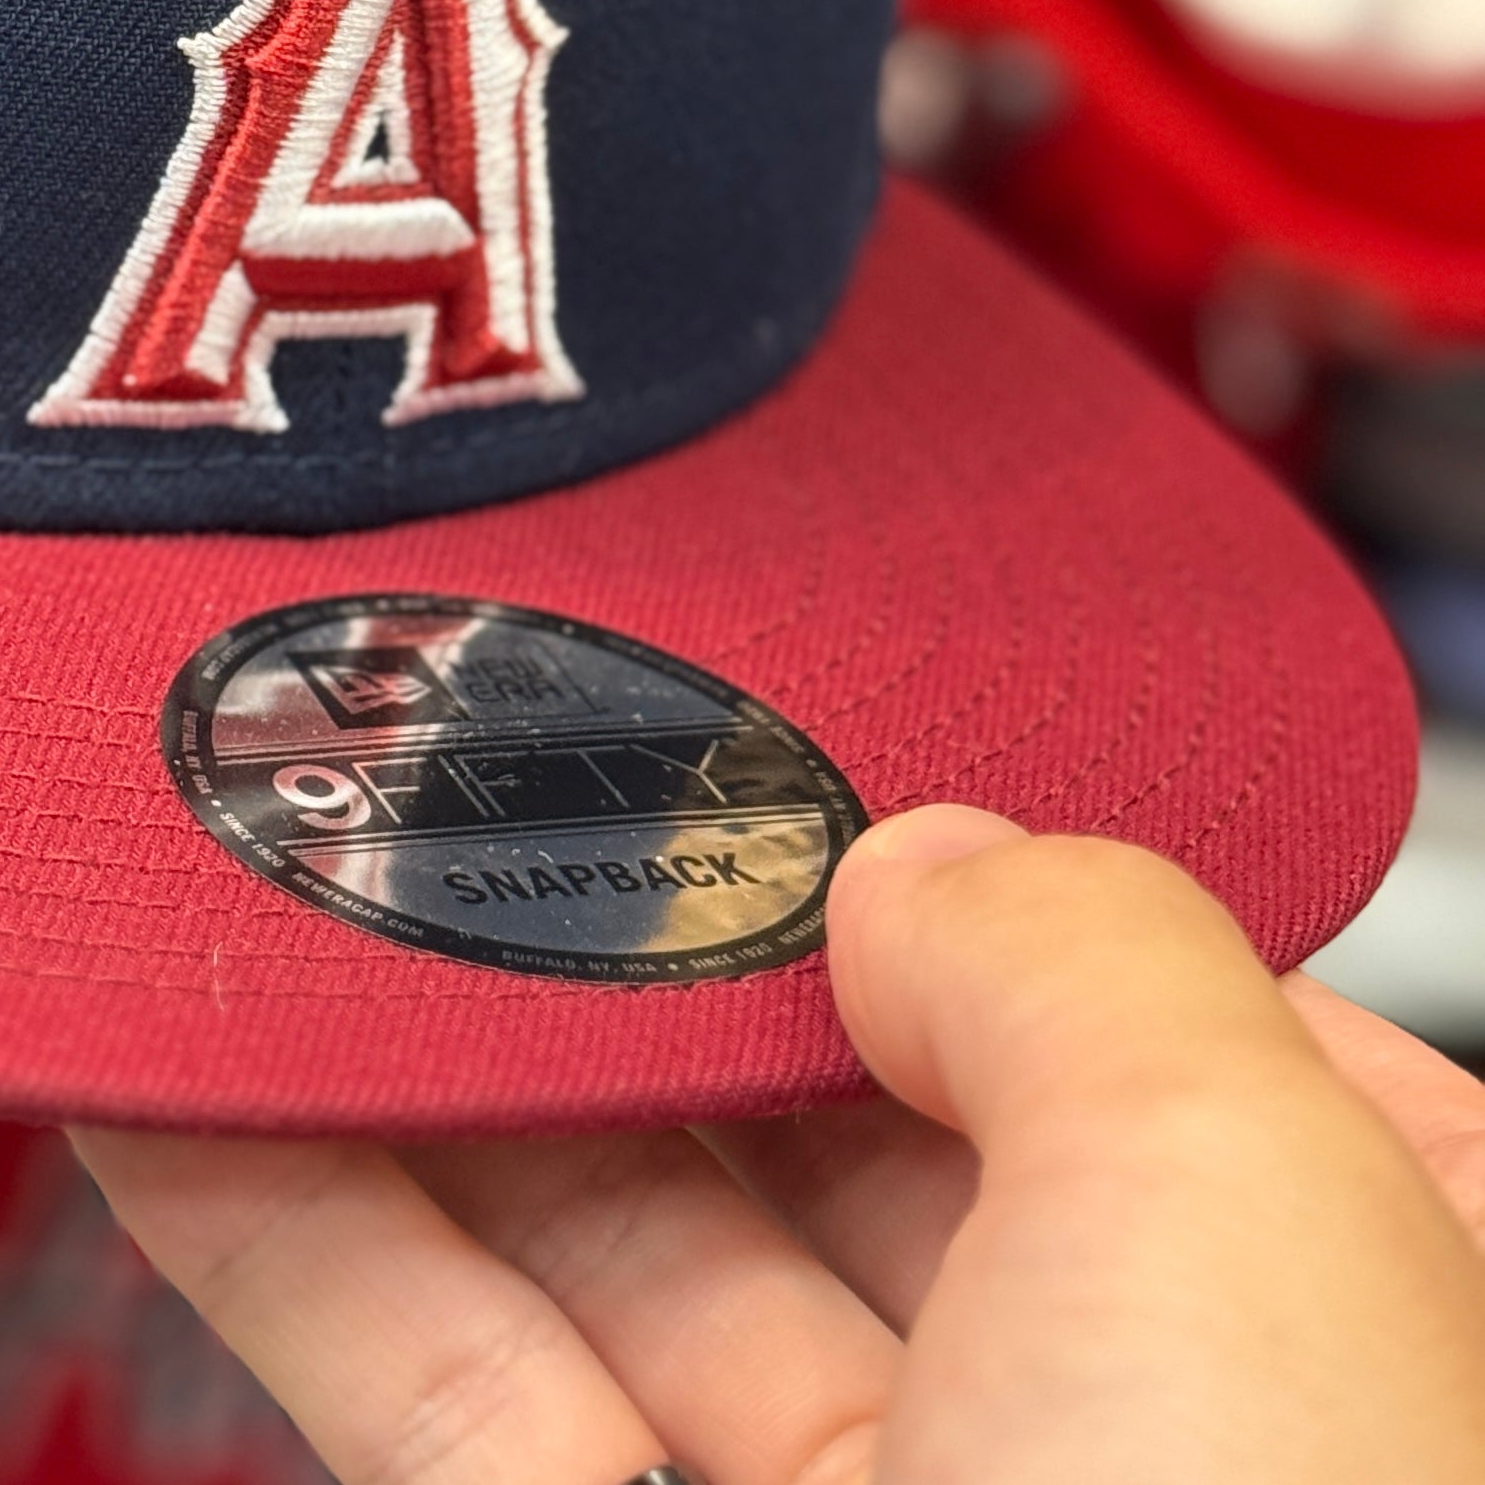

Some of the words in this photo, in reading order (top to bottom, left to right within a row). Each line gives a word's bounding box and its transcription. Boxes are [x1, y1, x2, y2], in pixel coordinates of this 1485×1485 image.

[450, 656, 543, 680] NEW
[466, 677, 566, 703] ERA
[219, 812, 255, 844] SINCE
[251, 843, 286, 869] 1920
[442, 853, 760, 906] SNAPBACK
[688, 952, 736, 969] SINCE
[735, 942, 773, 960] 1920
